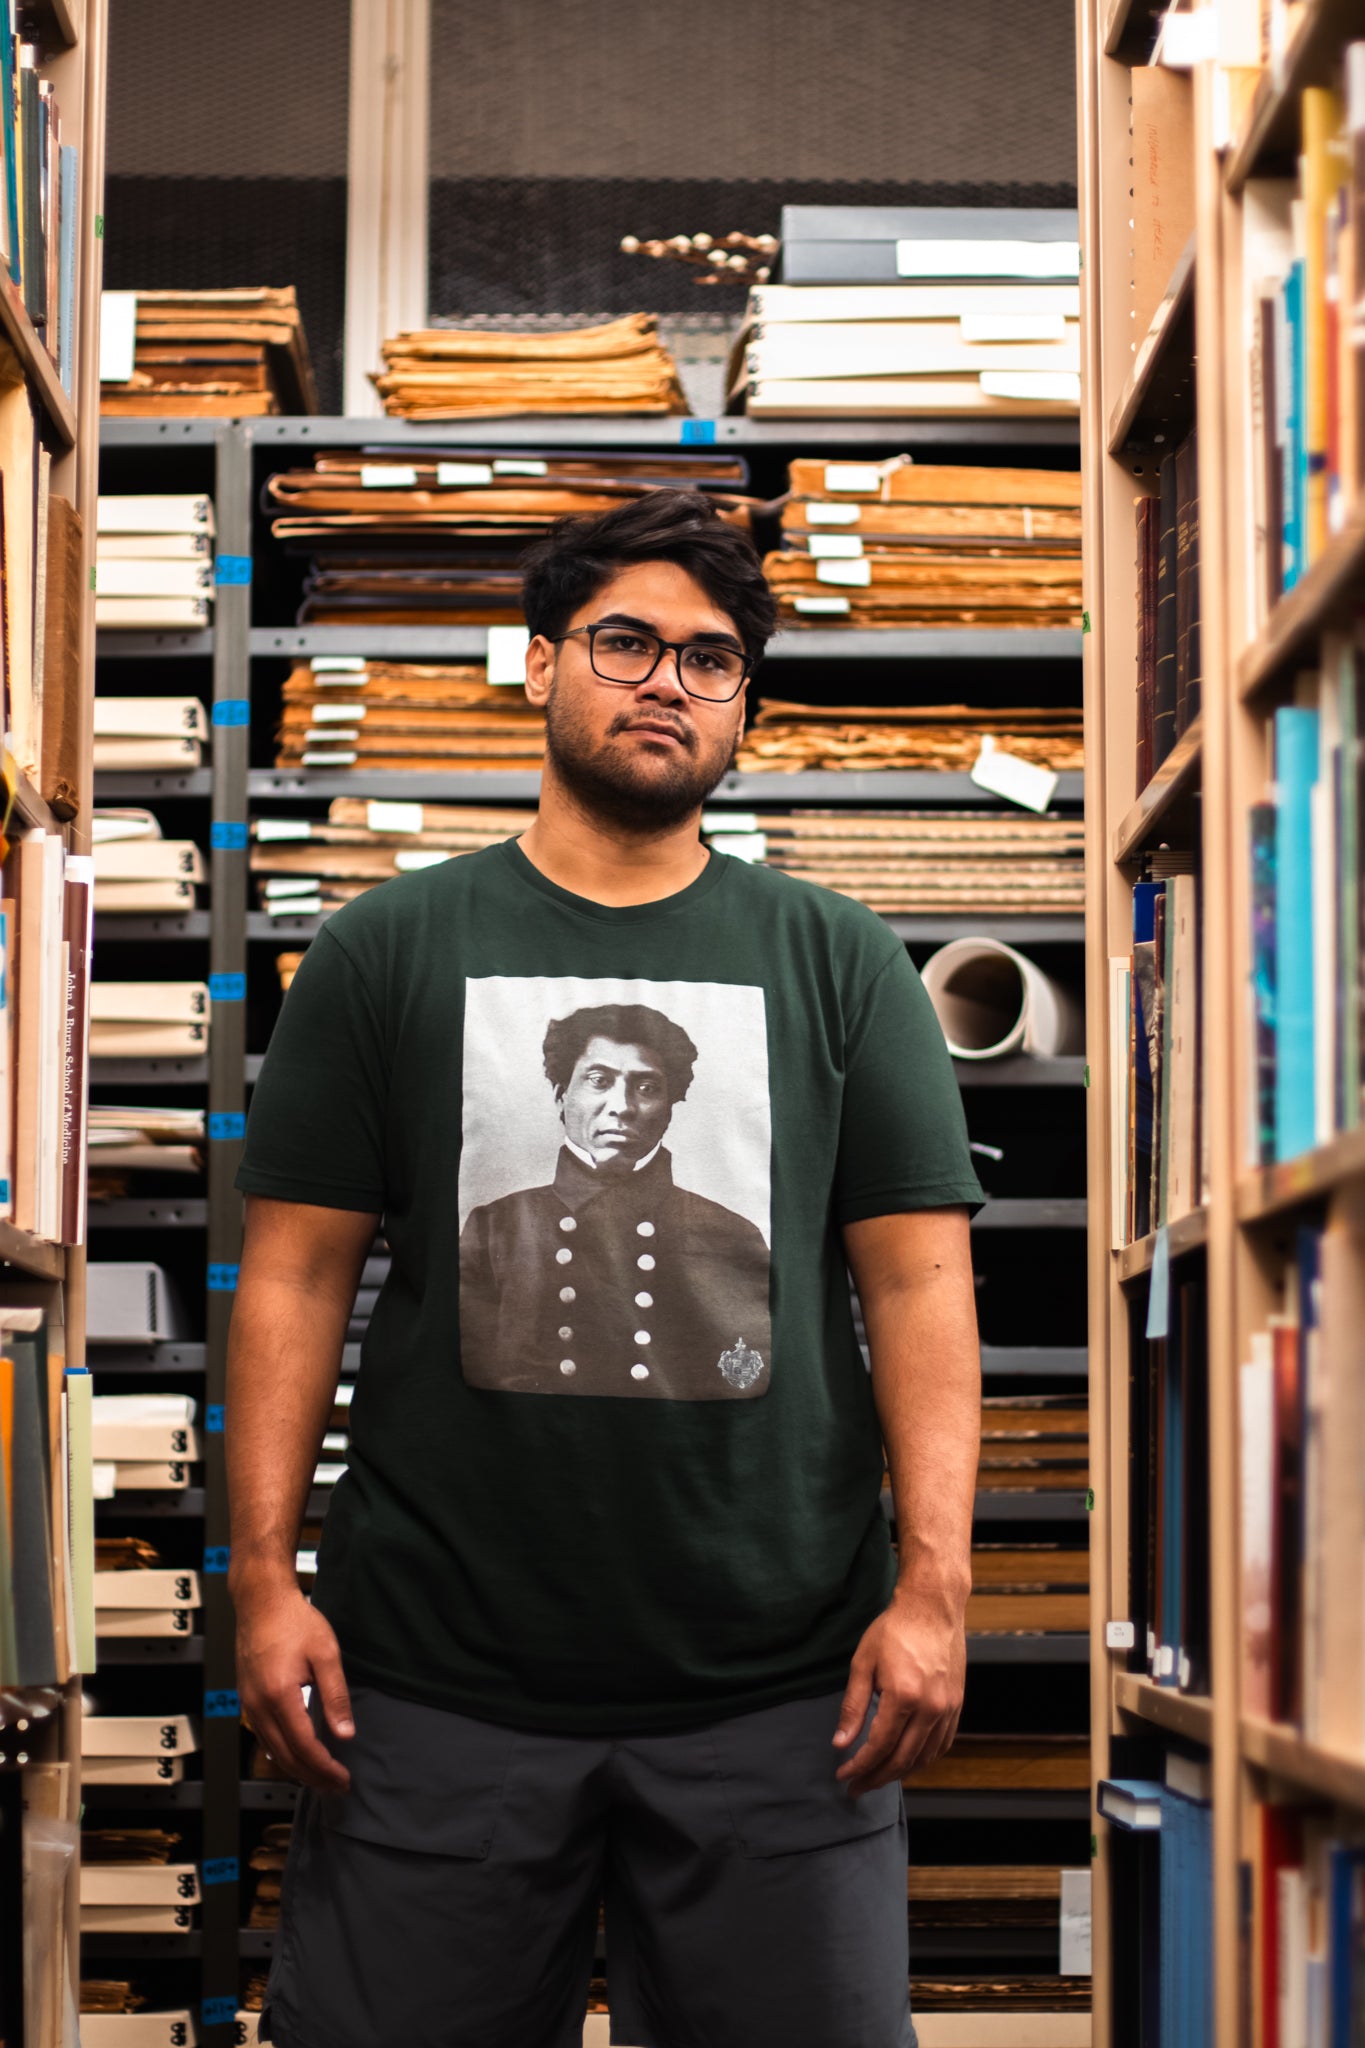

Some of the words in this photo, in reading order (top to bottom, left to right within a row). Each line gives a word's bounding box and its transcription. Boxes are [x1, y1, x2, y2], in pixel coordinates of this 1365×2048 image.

[67, 971, 77, 1000] John
[65, 1017, 75, 1053] Burns
[64, 1055, 74, 1094] School
[64, 1097, 73, 1110] of
[63, 1109, 73, 1165] Medicine
